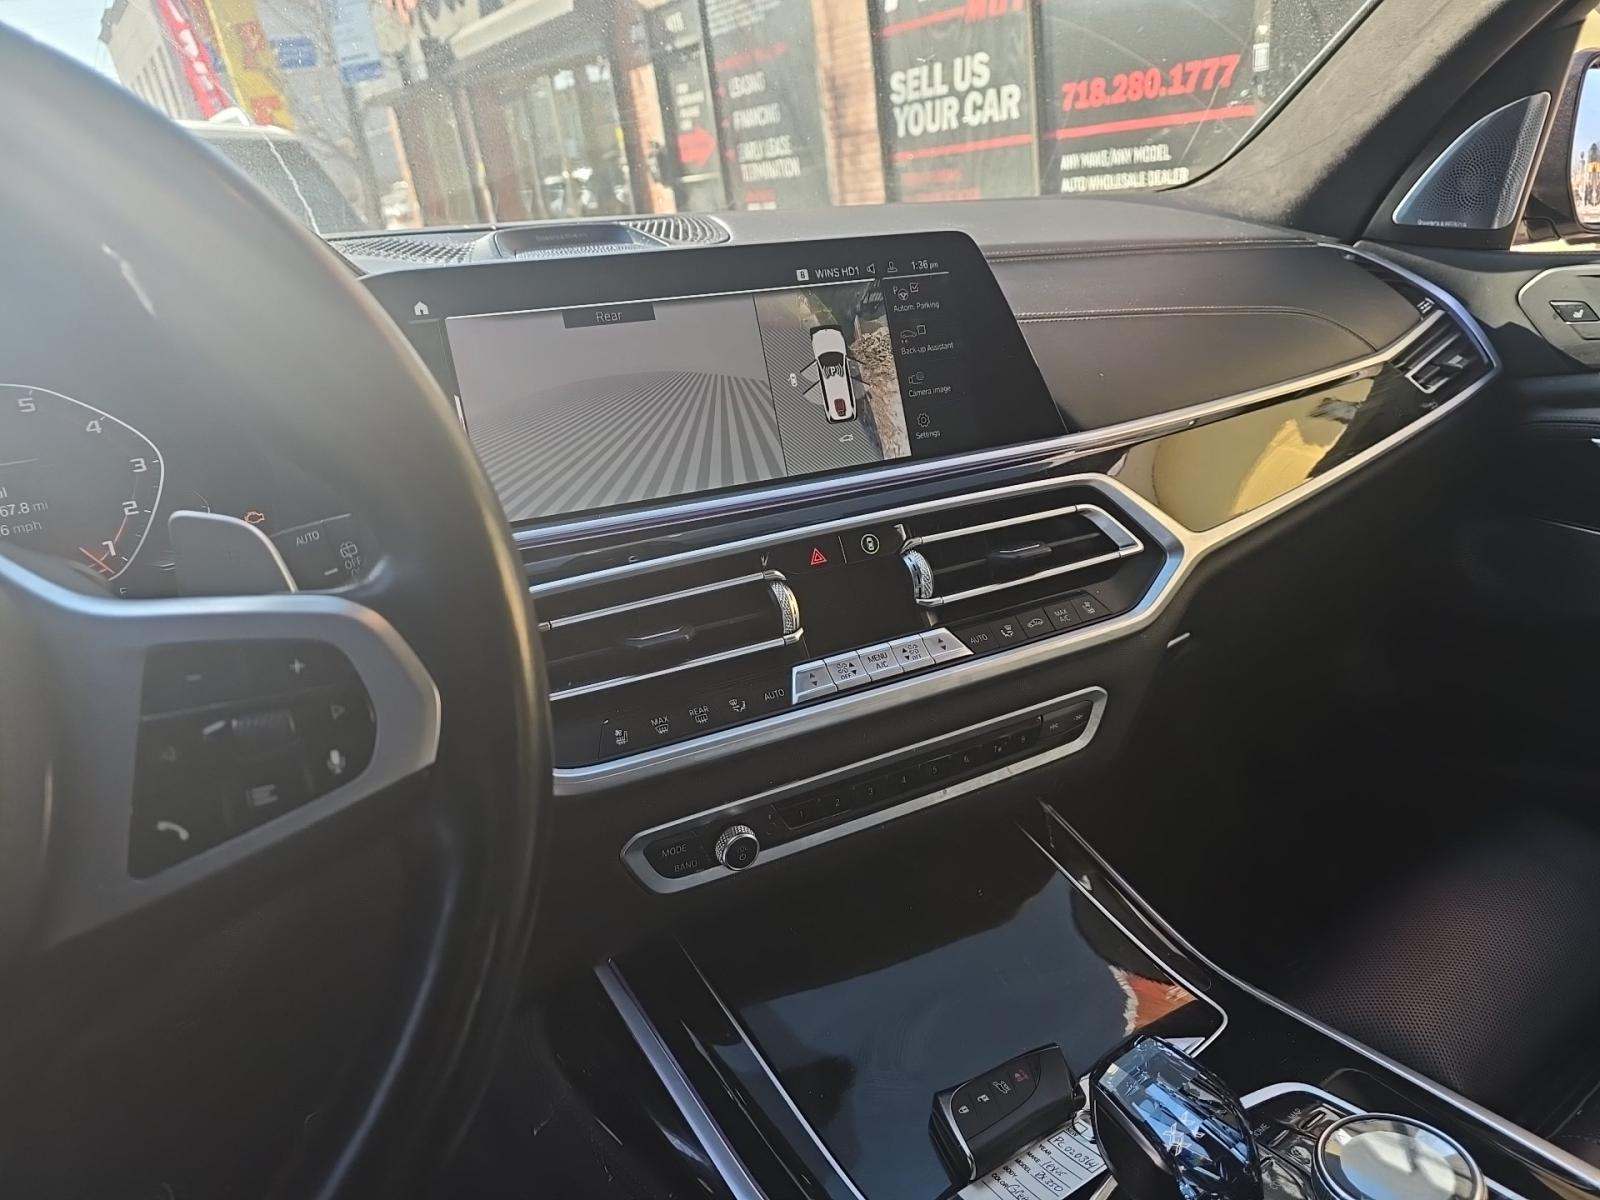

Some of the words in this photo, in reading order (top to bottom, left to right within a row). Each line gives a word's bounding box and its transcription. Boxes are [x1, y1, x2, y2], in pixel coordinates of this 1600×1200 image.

[889, 62, 949, 105] SELL
[953, 51, 991, 92] US
[1061, 53, 1240, 112] 718.280.1777
[892, 95, 960, 138] YOUR
[963, 84, 1021, 127] CAR
[1133, 143, 1172, 163] MODEL
[1060, 176, 1088, 193] AUTO
[1087, 170, 1147, 191] WHOLESALE
[1148, 166, 1190, 187] DEALER
[815, 267, 840, 279] WINS
[841, 265, 860, 277] HD1
[911, 259, 928, 271] 1:36
[916, 301, 940, 310] Parking
[595, 310, 624, 324] Rear
[908, 388, 933, 398] Camera
[18, 397, 36, 414] 5
[86, 419, 102, 434] 4
[915, 430, 941, 440] Settings
[129, 457, 147, 473] 3
[32, 501, 49, 512] mi
[122, 500, 139, 516] 2
[12, 520, 42, 534] mph
[295, 531, 320, 546] AUTO
[344, 556, 361, 570] OFF
[970, 633, 988, 645] AUTO
[867, 652, 889, 664] MENU
[875, 661, 889, 670] A/C
[764, 688, 785, 701] AUTO
[689, 705, 709, 717] REAR
[650, 715, 670, 728] MAX
[660, 843, 688, 858] MODE
[674, 860, 698, 873] BAND
[1026, 1151, 1041, 1163] MAKE
[1039, 1144, 1052, 1156] YEAR
[1003, 1165, 1018, 1178] BODY
[1014, 1158, 1031, 1174] MODEL
[991, 1172, 1010, 1189] COLOR
